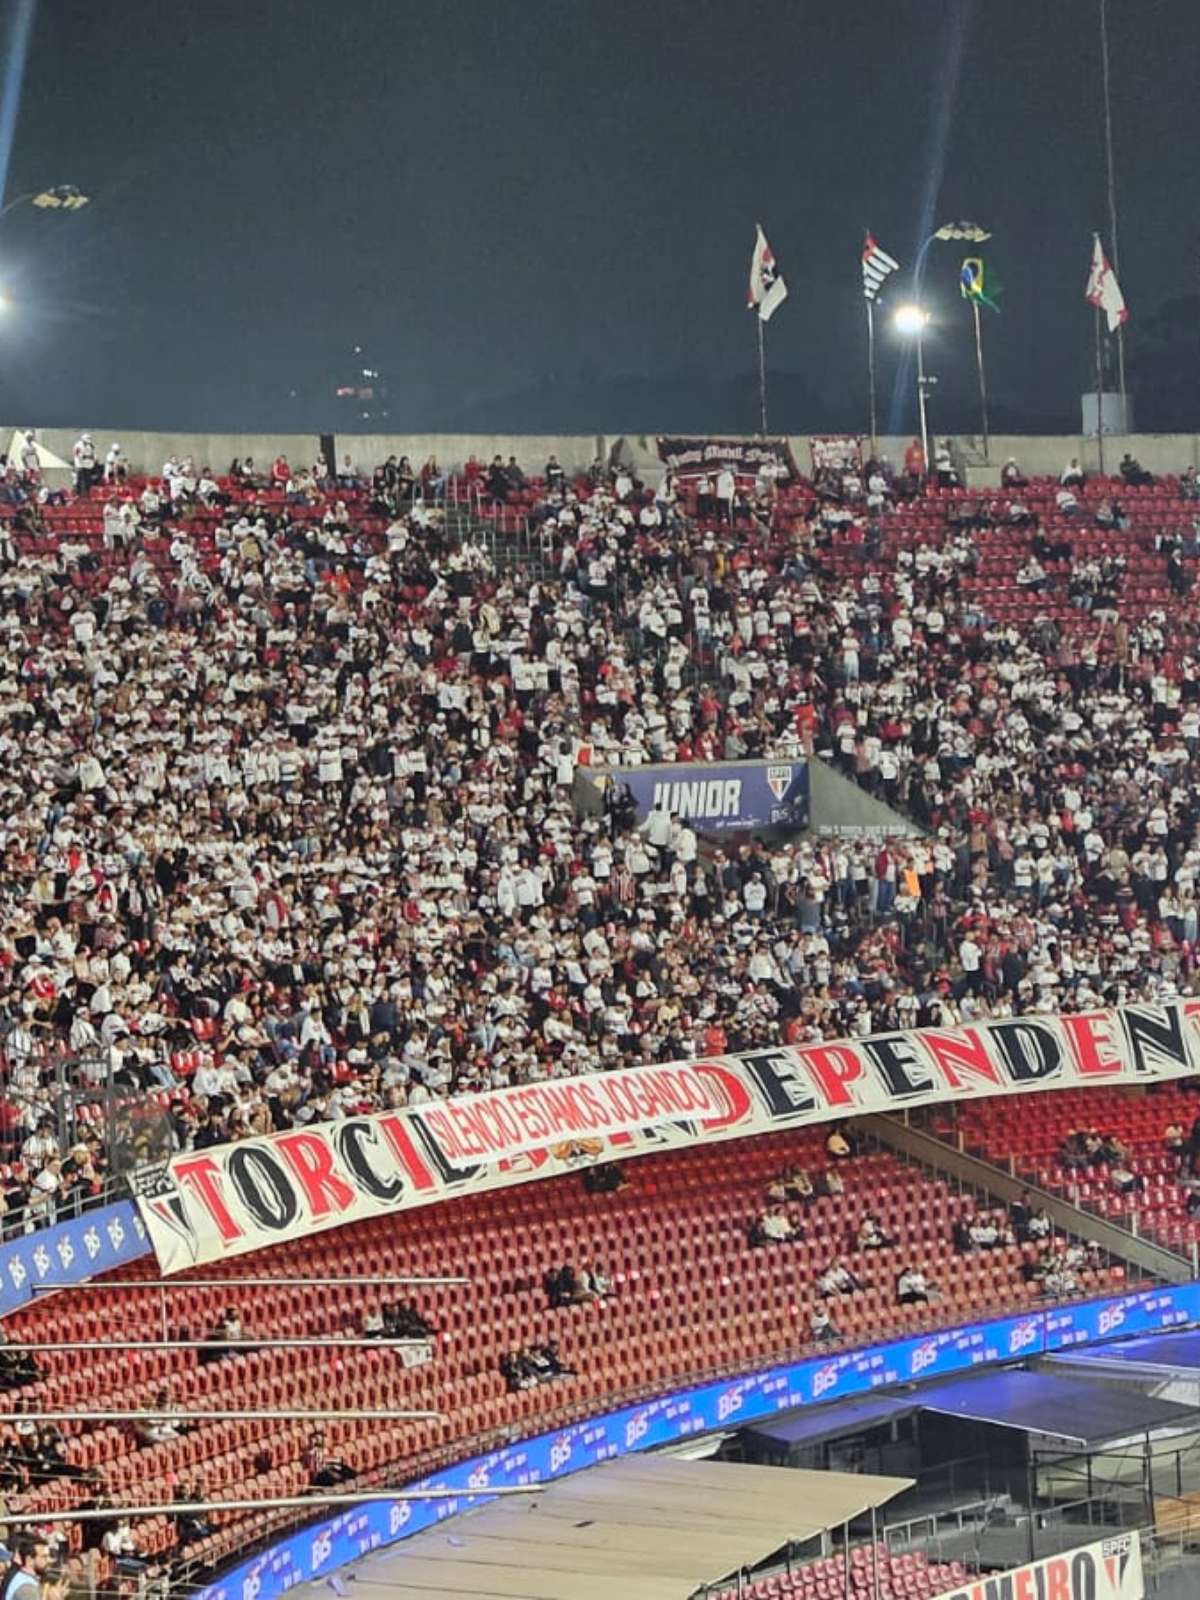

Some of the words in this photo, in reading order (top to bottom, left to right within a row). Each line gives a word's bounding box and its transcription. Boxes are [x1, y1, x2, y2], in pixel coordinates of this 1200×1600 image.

[654, 779, 742, 818] JUNIOR
[608, 1004, 1200, 1147] DEPENDEN
[507, 1083, 612, 1140] ESTAMOS
[599, 1068, 710, 1126] JOGANDO
[1104, 1537, 1131, 1557] SPFC
